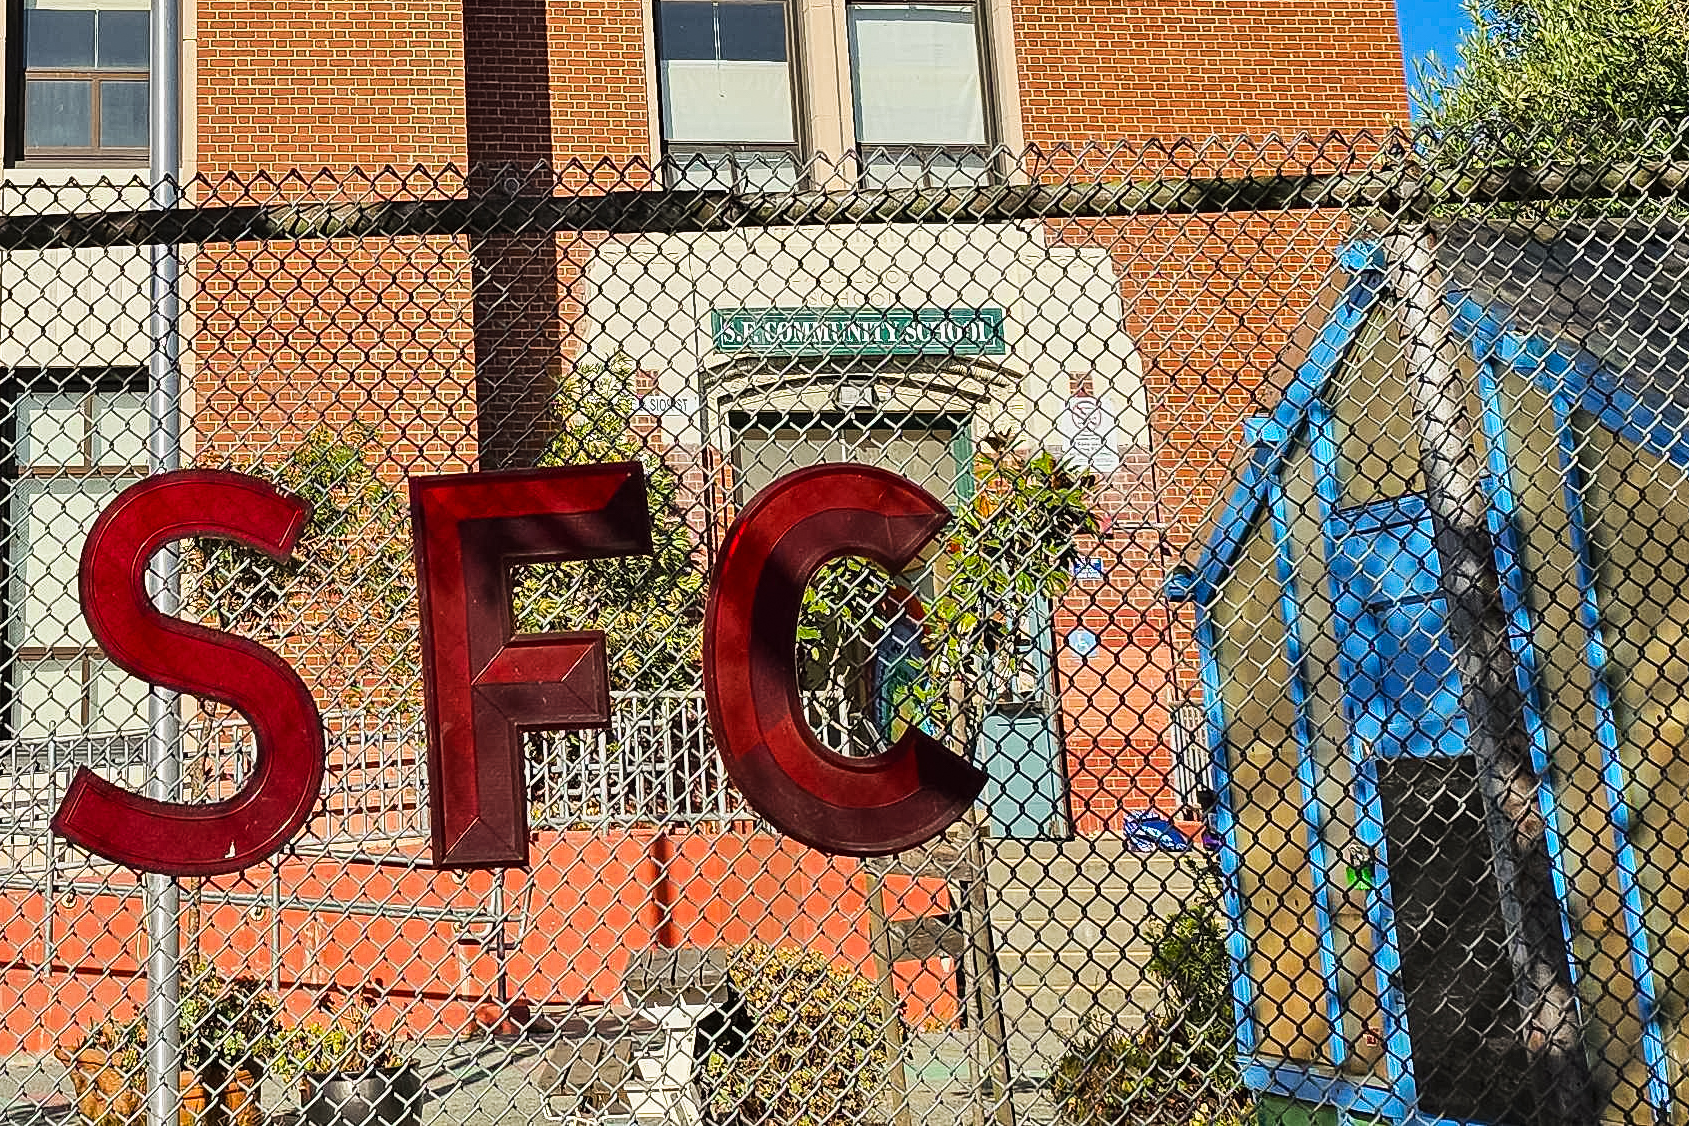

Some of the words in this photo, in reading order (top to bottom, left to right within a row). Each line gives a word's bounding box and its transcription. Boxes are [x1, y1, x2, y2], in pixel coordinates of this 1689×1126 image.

[764, 321, 899, 343] COMMUNITY
[904, 321, 989, 343] SCHOOL
[51, 461, 987, 875] SFC
